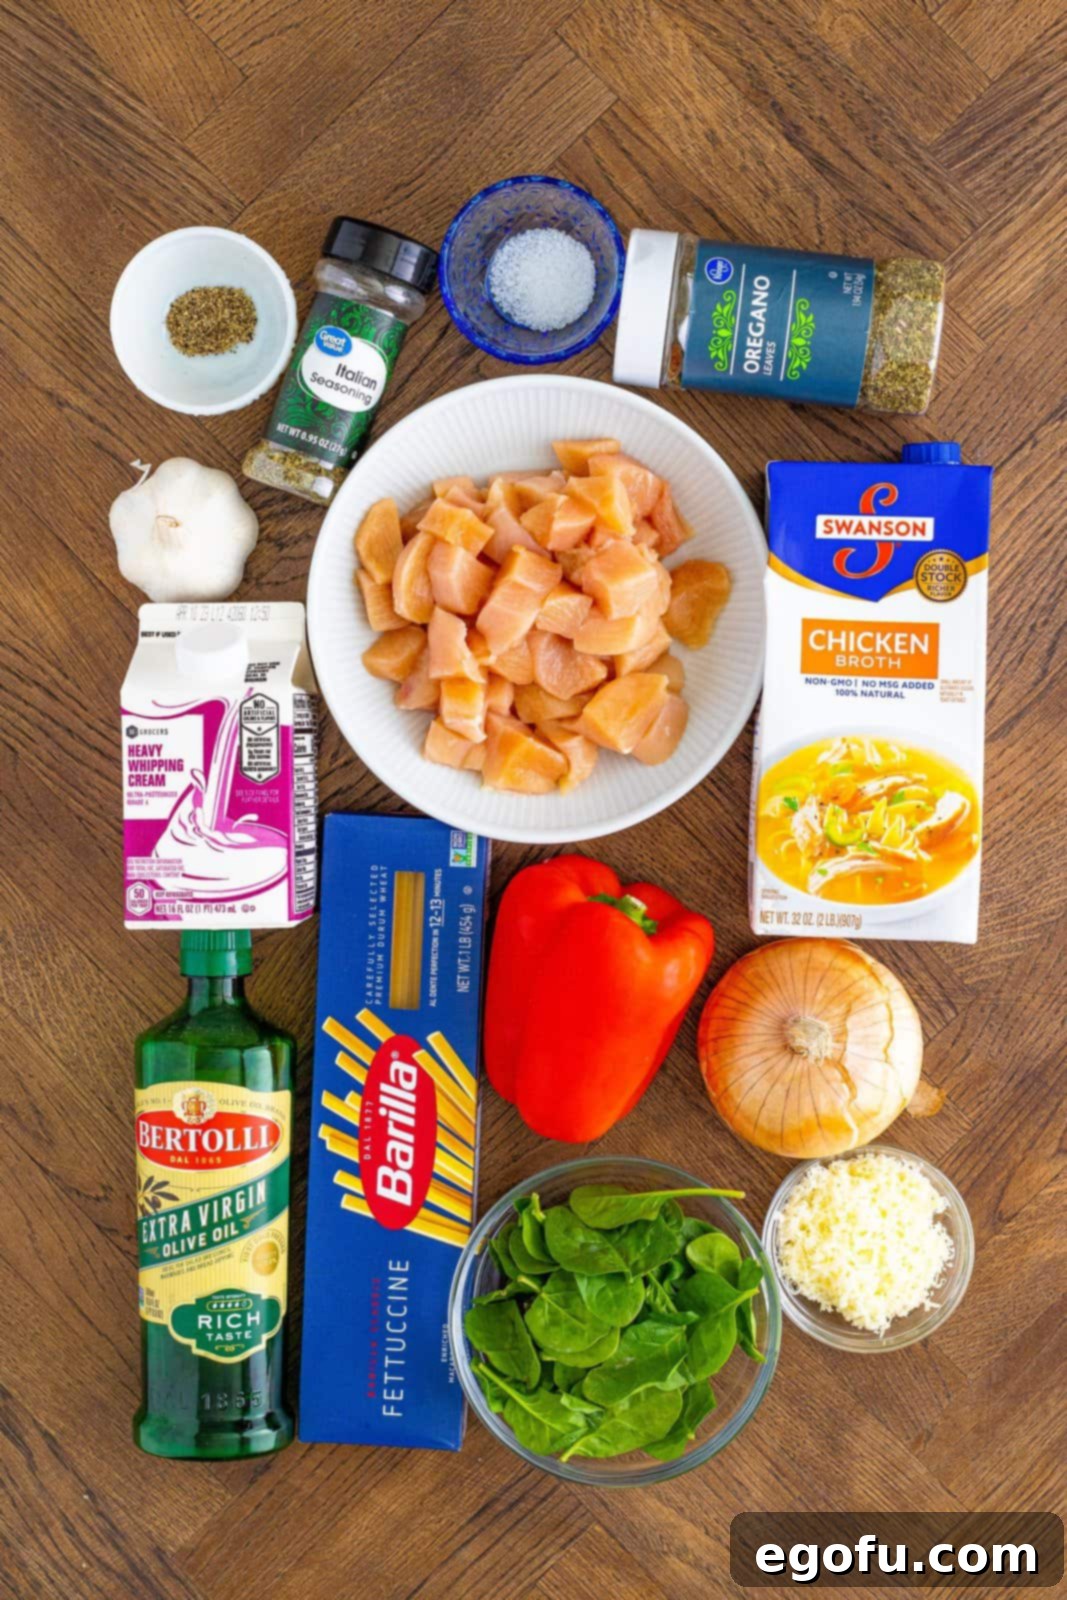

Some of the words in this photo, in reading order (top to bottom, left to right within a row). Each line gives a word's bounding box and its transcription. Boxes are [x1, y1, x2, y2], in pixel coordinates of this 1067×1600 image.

[743, 275, 770, 374] OREGANO
[319, 330, 346, 346] Great
[763, 341, 776, 376] LEAVES
[335, 363, 377, 391] Italian
[310, 372, 373, 406] Seasoning
[276, 422, 288, 433] NET
[288, 426, 301, 439] WT
[318, 437, 330, 448] OZ
[822, 518, 927, 537] SWANSON
[921, 572, 962, 582] STOCK
[923, 563, 959, 572] DOUBLE
[808, 628, 930, 655] CHICKEN
[835, 655, 902, 670] BROTH
[804, 677, 853, 687] NON-GMO
[861, 679, 877, 688] NO
[878, 679, 899, 689] MSG
[901, 680, 935, 690] ADDED
[835, 689, 858, 698] 100%
[860, 689, 905, 699] NATURAL
[253, 700, 265, 709] NO
[140, 728, 169, 736] GROCERS
[127, 744, 163, 757] HEAVY
[127, 758, 184, 772] WHIPPING
[128, 774, 166, 787] CREAM
[133, 888, 145, 899] 50
[379, 865, 389, 903] WHEAT
[434, 868, 443, 898] MINUTES
[368, 864, 379, 927] SELECTED
[168, 904, 176, 914] 16
[177, 904, 184, 914] FL
[185, 904, 194, 914] OZ
[214, 904, 226, 914] 473
[429, 898, 442, 928] 12-13
[760, 910, 775, 924] NET
[776, 911, 790, 924] WT.
[791, 911, 801, 925] 32
[802, 912, 813, 926] OZ.
[377, 909, 387, 948] DURUM
[459, 915, 474, 935] (454
[458, 936, 472, 949] LB
[430, 934, 440, 975] PERFECTION
[365, 934, 376, 1006] CAREFULLY
[374, 953, 385, 1006] PREMIUM
[456, 975, 470, 993] NET
[217, 1098, 247, 1108] OLIVE
[363, 1101, 374, 1130] 1877
[138, 1119, 271, 1153] BERTOLLI
[376, 1060, 418, 1206] Barilla
[169, 1155, 189, 1164] DAL
[363, 1137, 372, 1161] DAL
[142, 1209, 192, 1244] EXTRA
[199, 1180, 267, 1227] VIRGIN
[162, 1232, 207, 1258] OLIVE
[212, 1222, 239, 1243] OIL
[197, 1311, 260, 1330] RICH
[205, 1331, 252, 1342] TASTE
[382, 1259, 409, 1417] FETTUCCINE
[440, 1323, 449, 1363] ENRICHED
